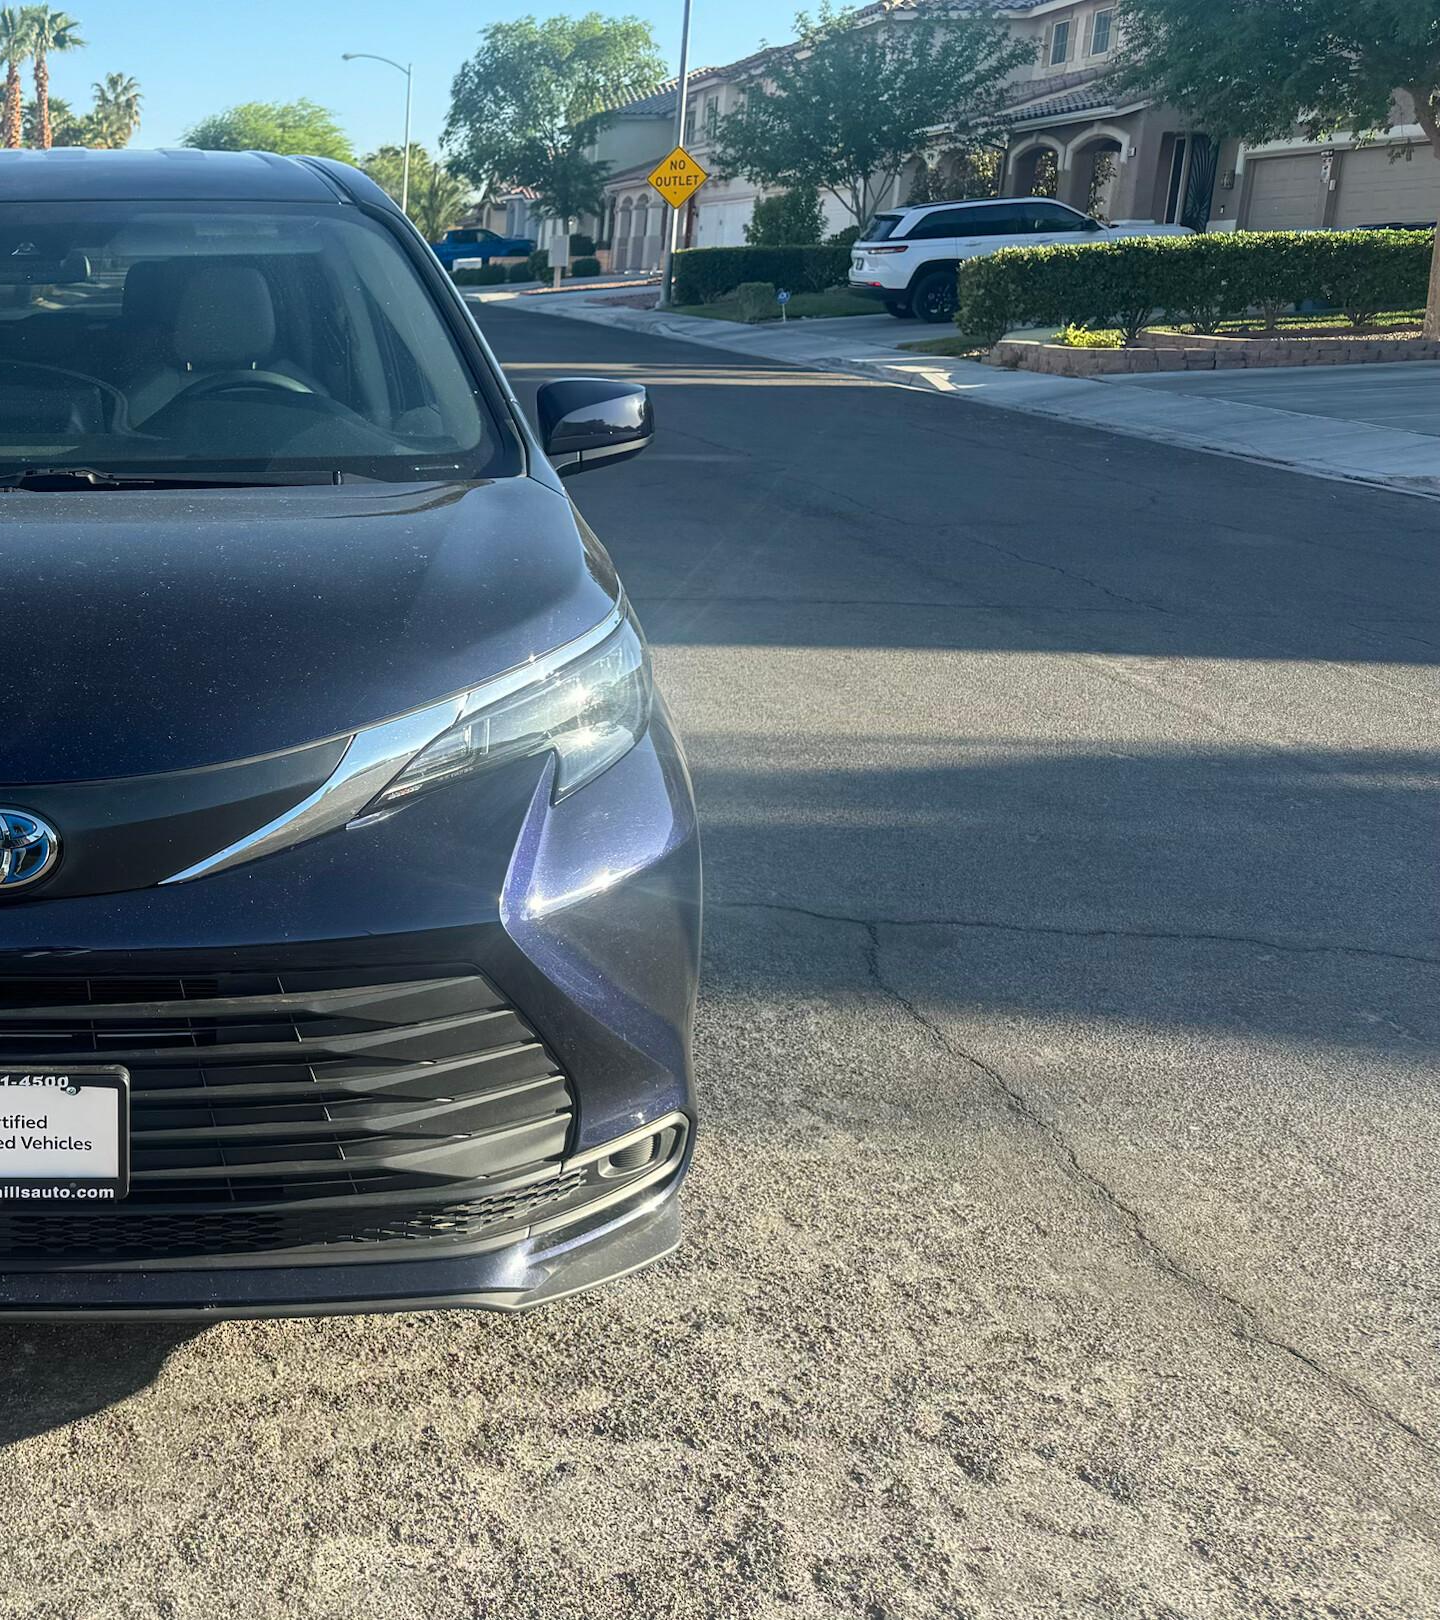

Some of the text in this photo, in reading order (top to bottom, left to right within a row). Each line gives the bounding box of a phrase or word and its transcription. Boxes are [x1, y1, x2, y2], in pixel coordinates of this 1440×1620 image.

[670, 160, 686, 170] NO
[655, 175, 700, 187] OUTLET
[20, 1136, 92, 1151] Vehicles
